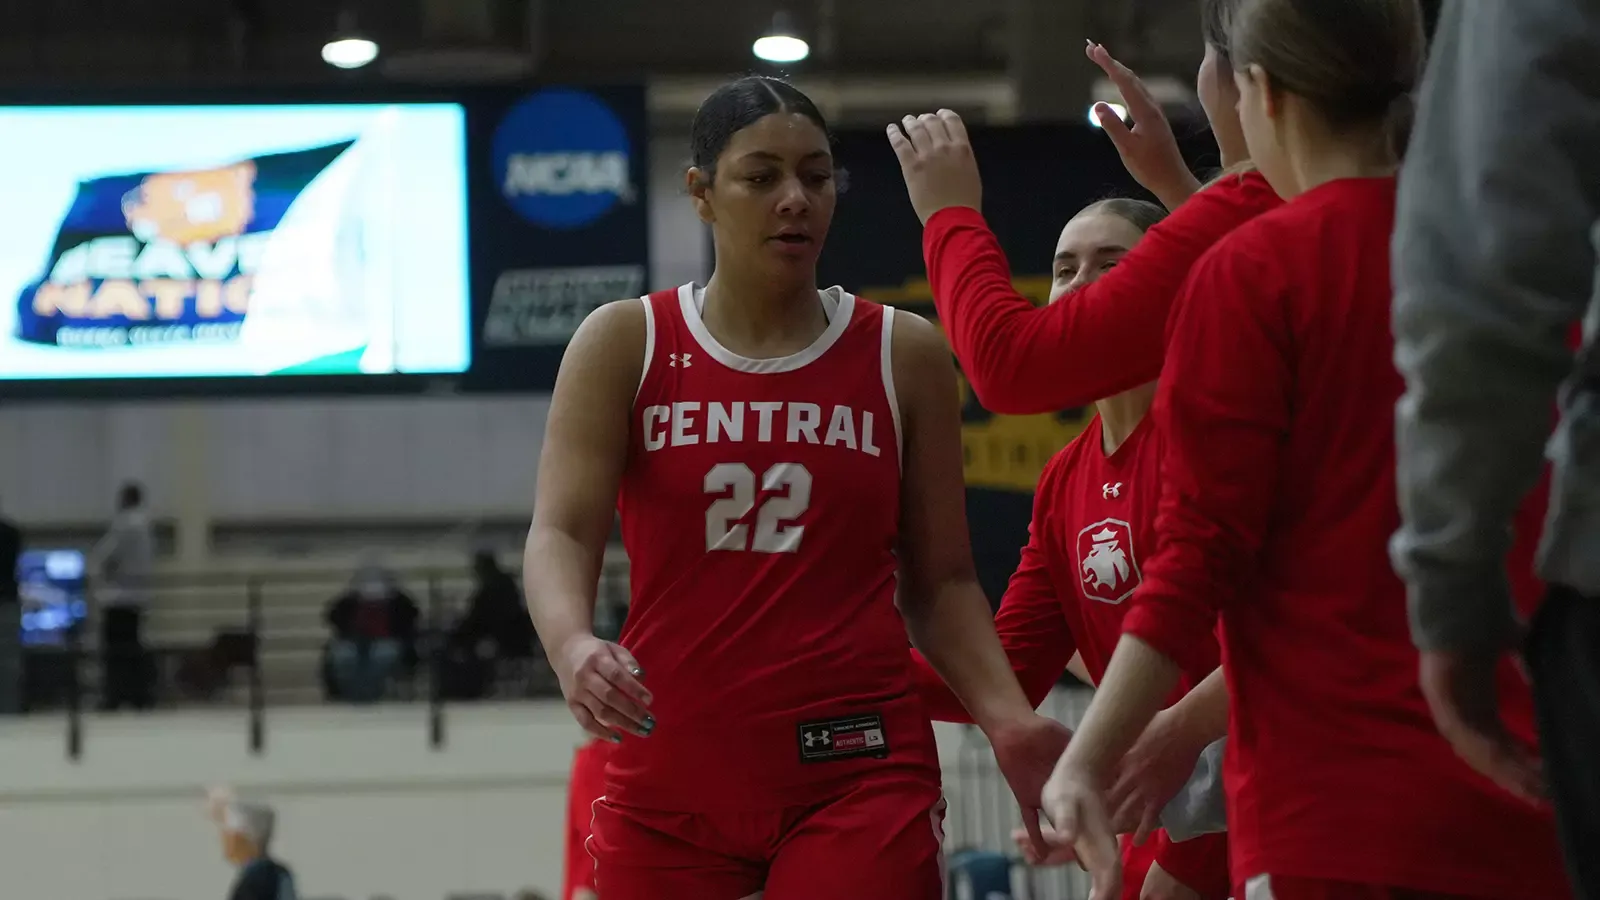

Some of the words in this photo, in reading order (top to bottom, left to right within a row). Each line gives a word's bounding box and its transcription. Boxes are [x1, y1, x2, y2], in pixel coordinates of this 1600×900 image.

[504, 152, 630, 198] NCAA
[643, 401, 880, 457] CENTRAL
[703, 462, 813, 554] 22
[835, 736, 865, 748] AUTHENTIC
